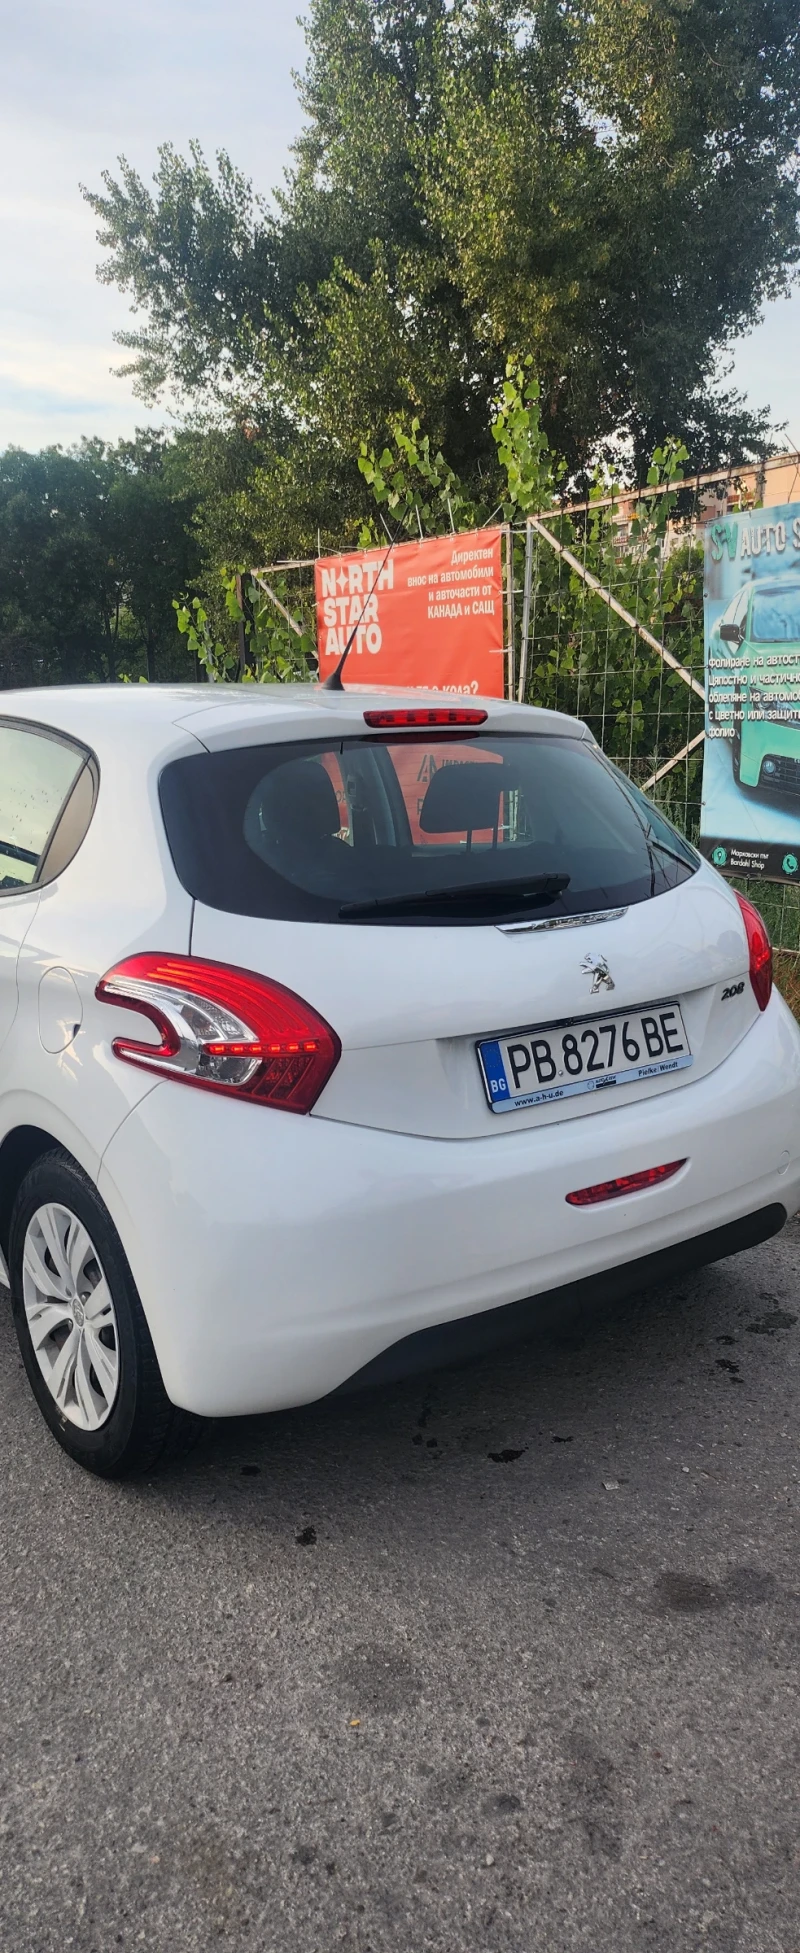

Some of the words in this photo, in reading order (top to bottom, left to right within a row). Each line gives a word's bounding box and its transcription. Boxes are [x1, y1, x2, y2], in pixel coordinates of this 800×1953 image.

[740, 522, 786, 557] AUTO
[450, 548, 494, 566] Директен
[407, 575, 427, 587] внос
[428, 573, 439, 585] на
[440, 564, 494, 583] автомобили
[428, 591, 434, 602] и
[435, 585, 480, 601] авточасти
[482, 585, 492, 596] от
[323, 593, 379, 627] STAR
[427, 603, 462, 619] КАНАДА
[464, 604, 470, 615] и
[472, 600, 495, 616] САЩ
[325, 623, 382, 656] AUTO
[753, 656, 764, 667] на
[750, 675, 757, 685] и
[749, 691, 761, 702] на
[763, 690, 800, 702] автомо
[708, 711, 714, 720] с
[714, 710, 745, 721] цветно
[731, 858, 751, 867] Bardahl
[721, 981, 745, 1001] 208
[506, 1039, 557, 1089] PB
[561, 1021, 640, 1076] 8276
[641, 1011, 684, 1058] BE
[660, 1061, 678, 1072] Wendt
[491, 1078, 507, 1093] BG
[514, 1089, 564, 1108] www.a-h-u.de
